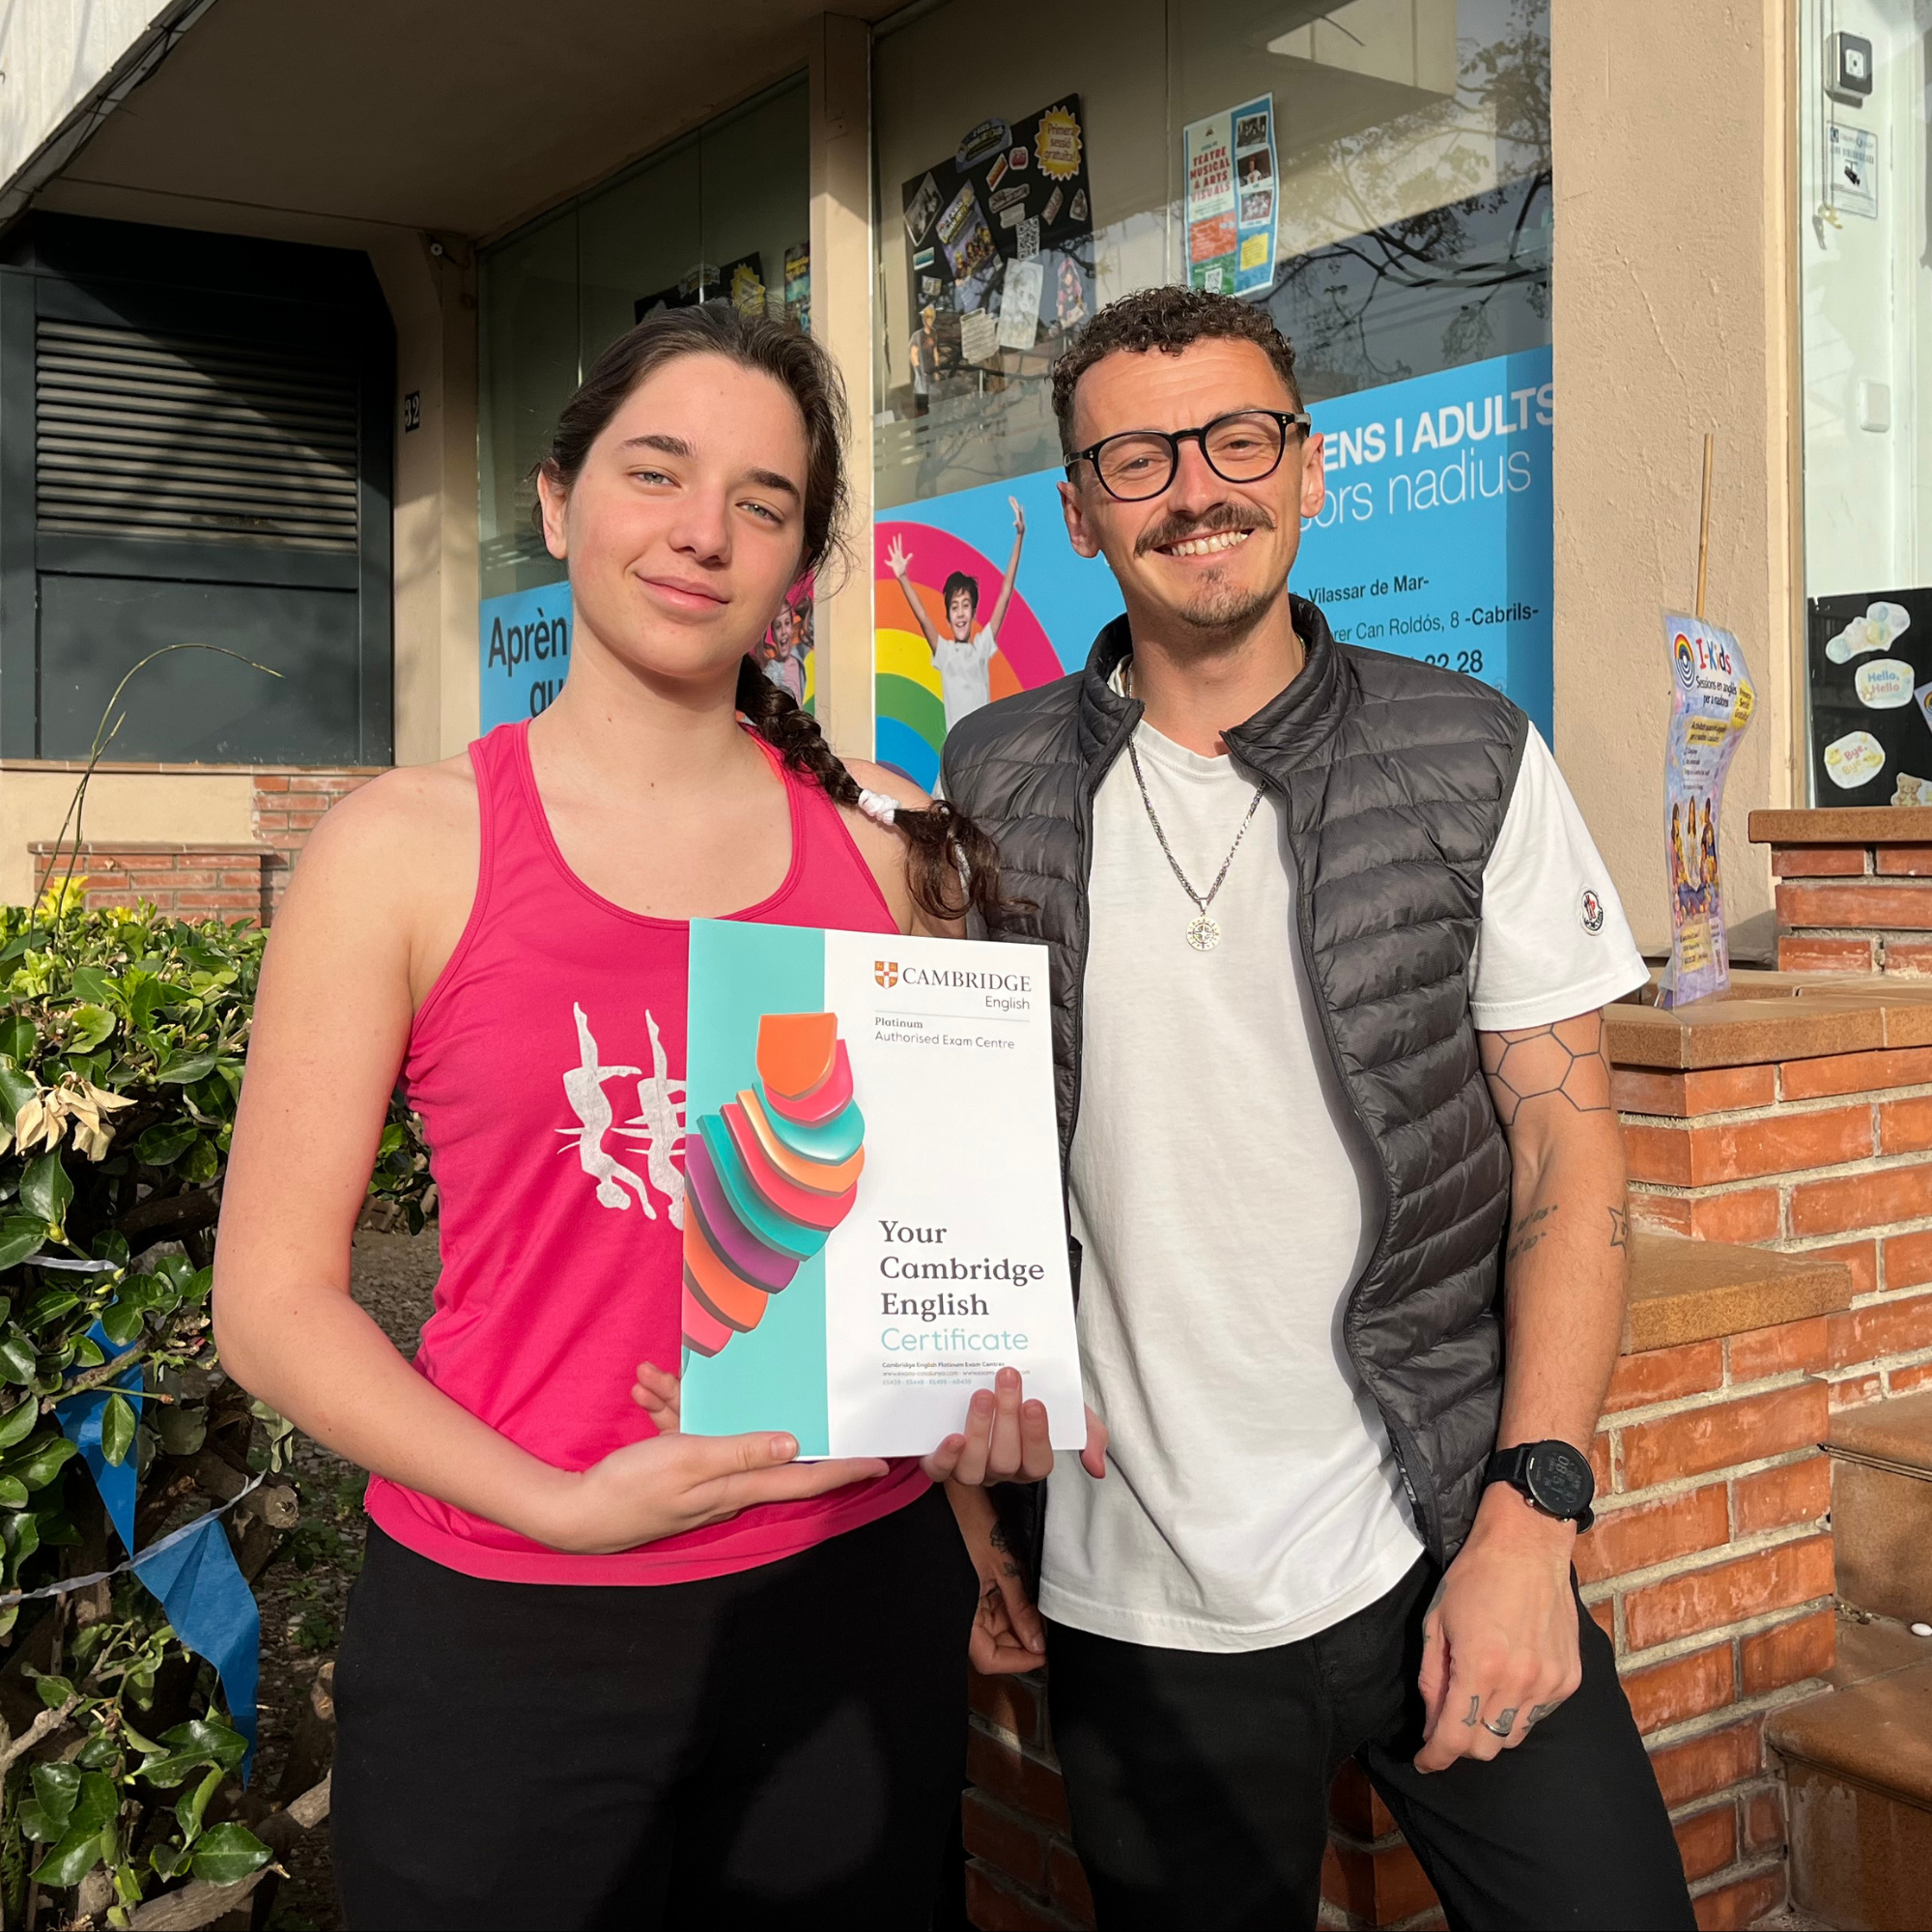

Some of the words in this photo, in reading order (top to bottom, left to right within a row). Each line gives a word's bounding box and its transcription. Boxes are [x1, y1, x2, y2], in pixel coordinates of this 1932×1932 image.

[1192, 146, 1227, 166] TEATRE
[1189, 158, 1231, 181] MUSICAL
[1194, 178, 1201, 190] &
[1203, 171, 1228, 187] ARTS
[1191, 184, 1231, 203] VISUALS
[1411, 383, 1553, 454] ADULTS
[1300, 482, 1374, 531] ors
[1389, 447, 1531, 515] nadius
[1370, 579, 1389, 596] de
[1393, 575, 1430, 593] Mar-
[1355, 622, 1384, 639] Can
[1389, 613, 1445, 637] Roldós,
[1450, 611, 1460, 629] 8
[1465, 602, 1539, 626] -Cabrils-
[488, 608, 568, 677] Aprèn
[1457, 649, 1483, 673] 28
[1695, 638, 1732, 675] I-Kids
[1696, 675, 1717, 691] Sessions
[1717, 682, 1722, 691] en
[1871, 681, 1900, 694] Hello
[1714, 695, 1729, 707] nadons
[1841, 759, 1862, 775] Bye
[902, 967, 1032, 992] CAMBRIDGE
[985, 996, 1031, 1012] English
[874, 1016, 923, 1029] Platinum
[874, 1031, 940, 1045] Authorised
[943, 1036, 973, 1047] Exam
[976, 1037, 1015, 1049] Centre
[878, 1220, 948, 1244] Your
[880, 1256, 1045, 1287] Cambridge
[881, 1293, 989, 1322] English
[881, 1327, 1029, 1350] Certificate
